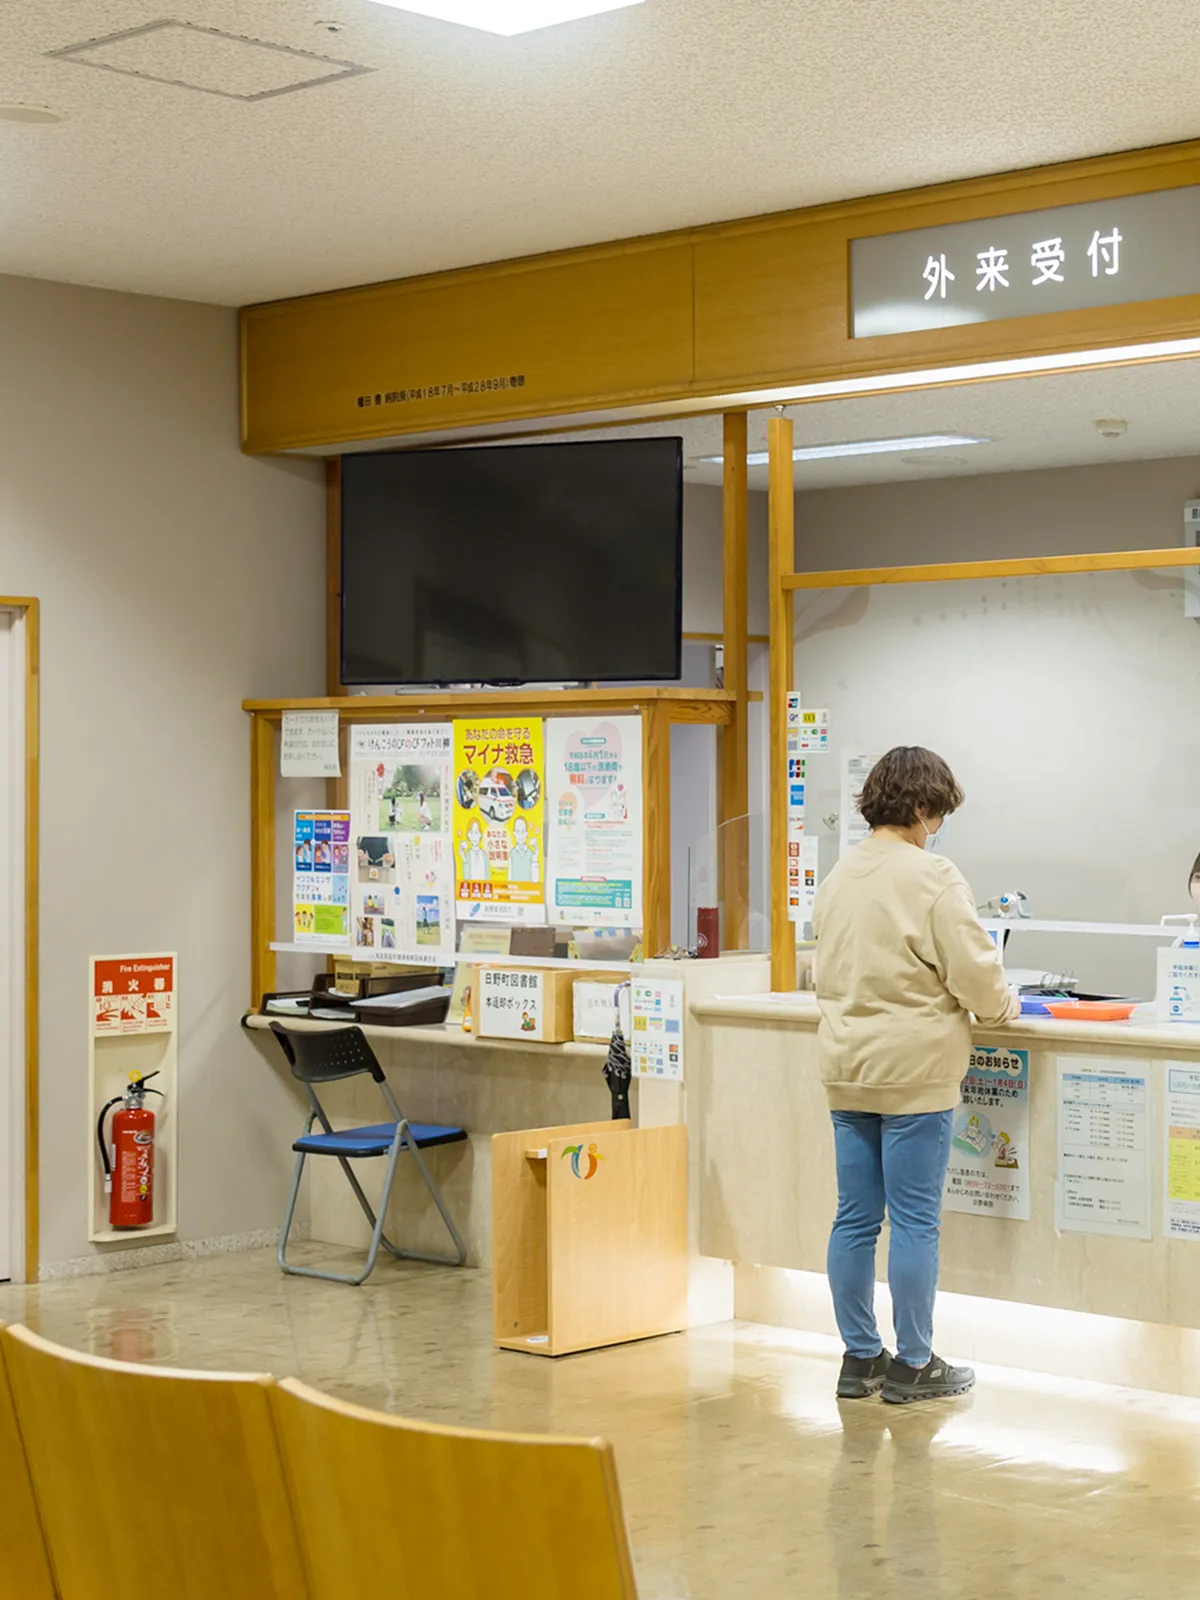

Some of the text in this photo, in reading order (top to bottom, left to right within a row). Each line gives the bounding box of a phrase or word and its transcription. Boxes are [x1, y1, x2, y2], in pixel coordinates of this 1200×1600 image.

[922, 227, 1122, 300] 外来受付
[466, 727, 531, 740] あなたの命を守る
[463, 743, 534, 765] マイナ救急
[133, 964, 170, 972] Extinguisher
[485, 972, 538, 989] 日野町図書館
[485, 997, 537, 1011] 本返却ボックス
